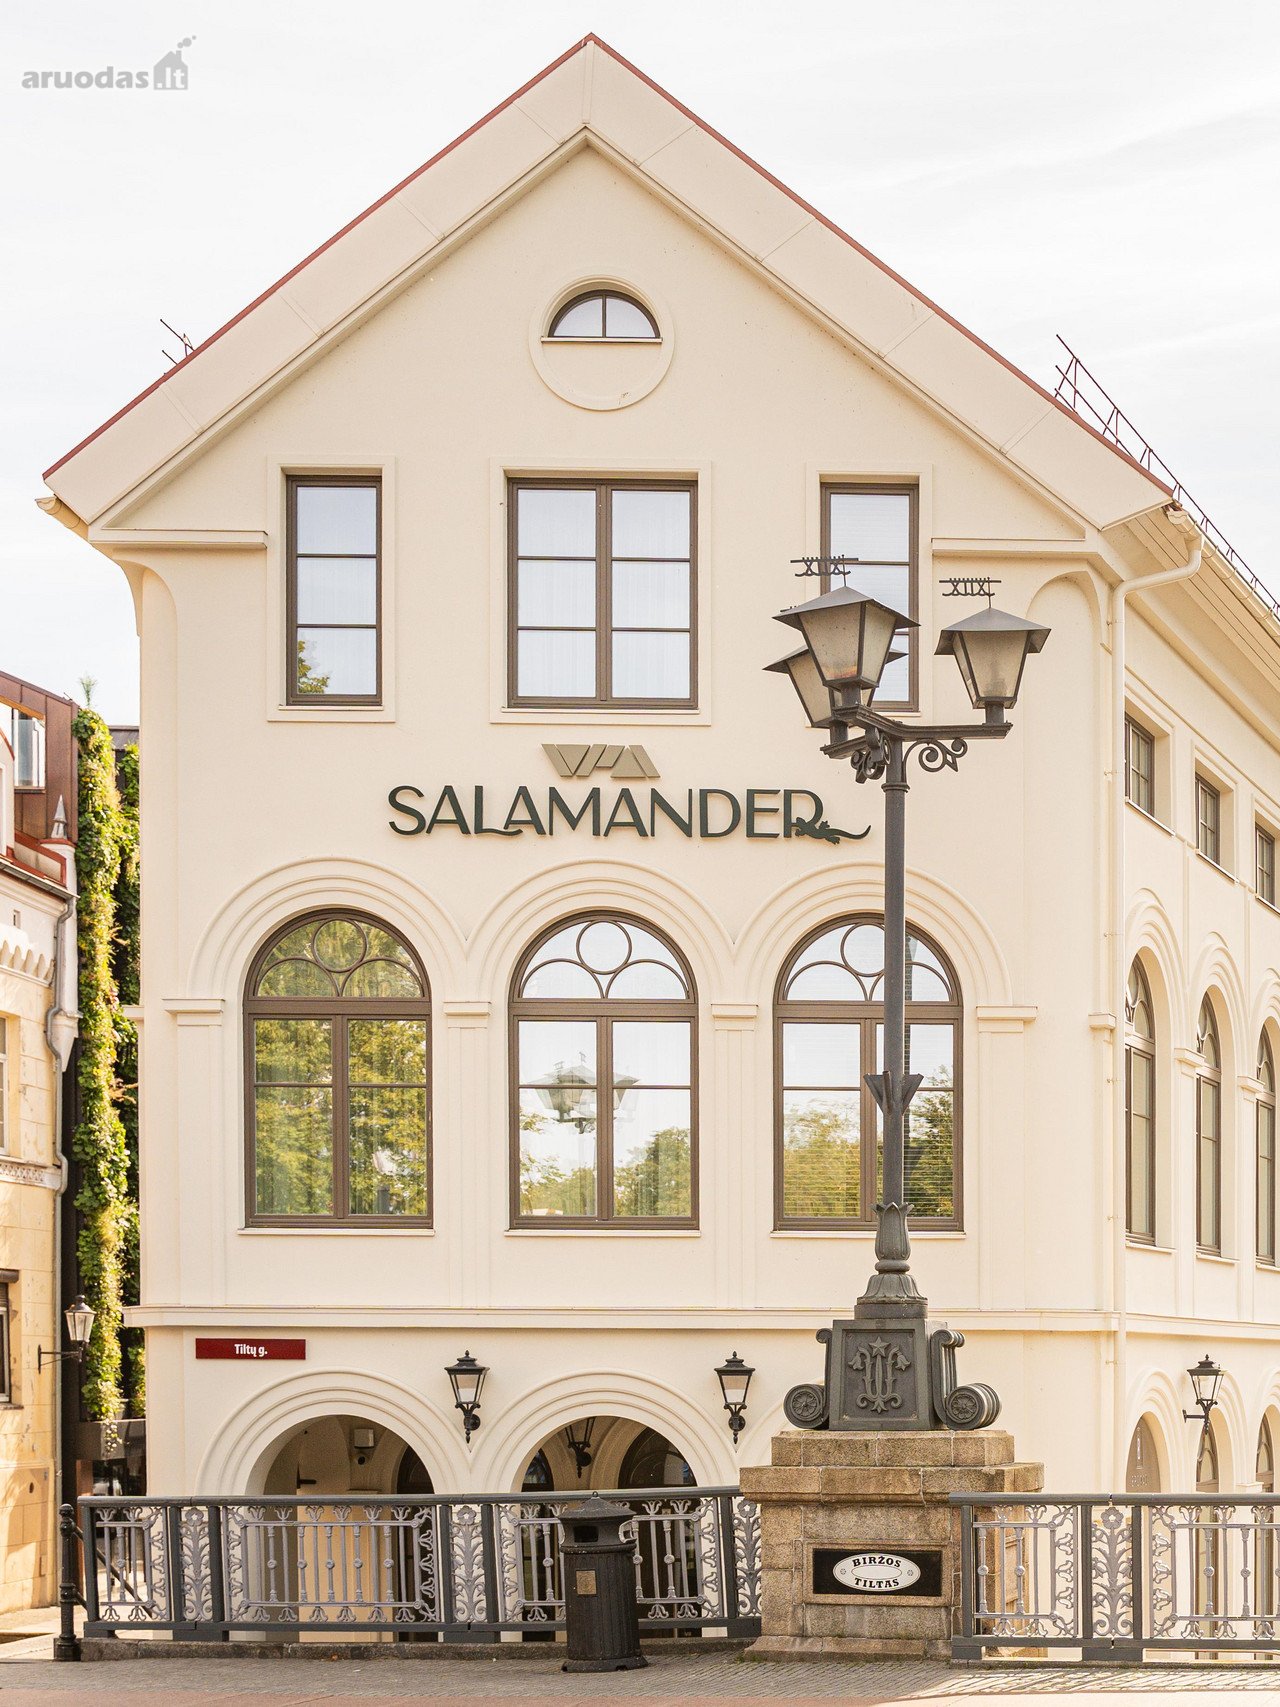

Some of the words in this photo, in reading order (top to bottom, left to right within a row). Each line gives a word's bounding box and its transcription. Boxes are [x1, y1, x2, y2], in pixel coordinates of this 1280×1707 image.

[387, 784, 871, 844] SALAMANDER
[234, 1344, 257, 1357] Tiltų
[258, 1346, 268, 1357] g.
[852, 1555, 902, 1568] BIRŽOS
[855, 1577, 900, 1589] TILTAS
